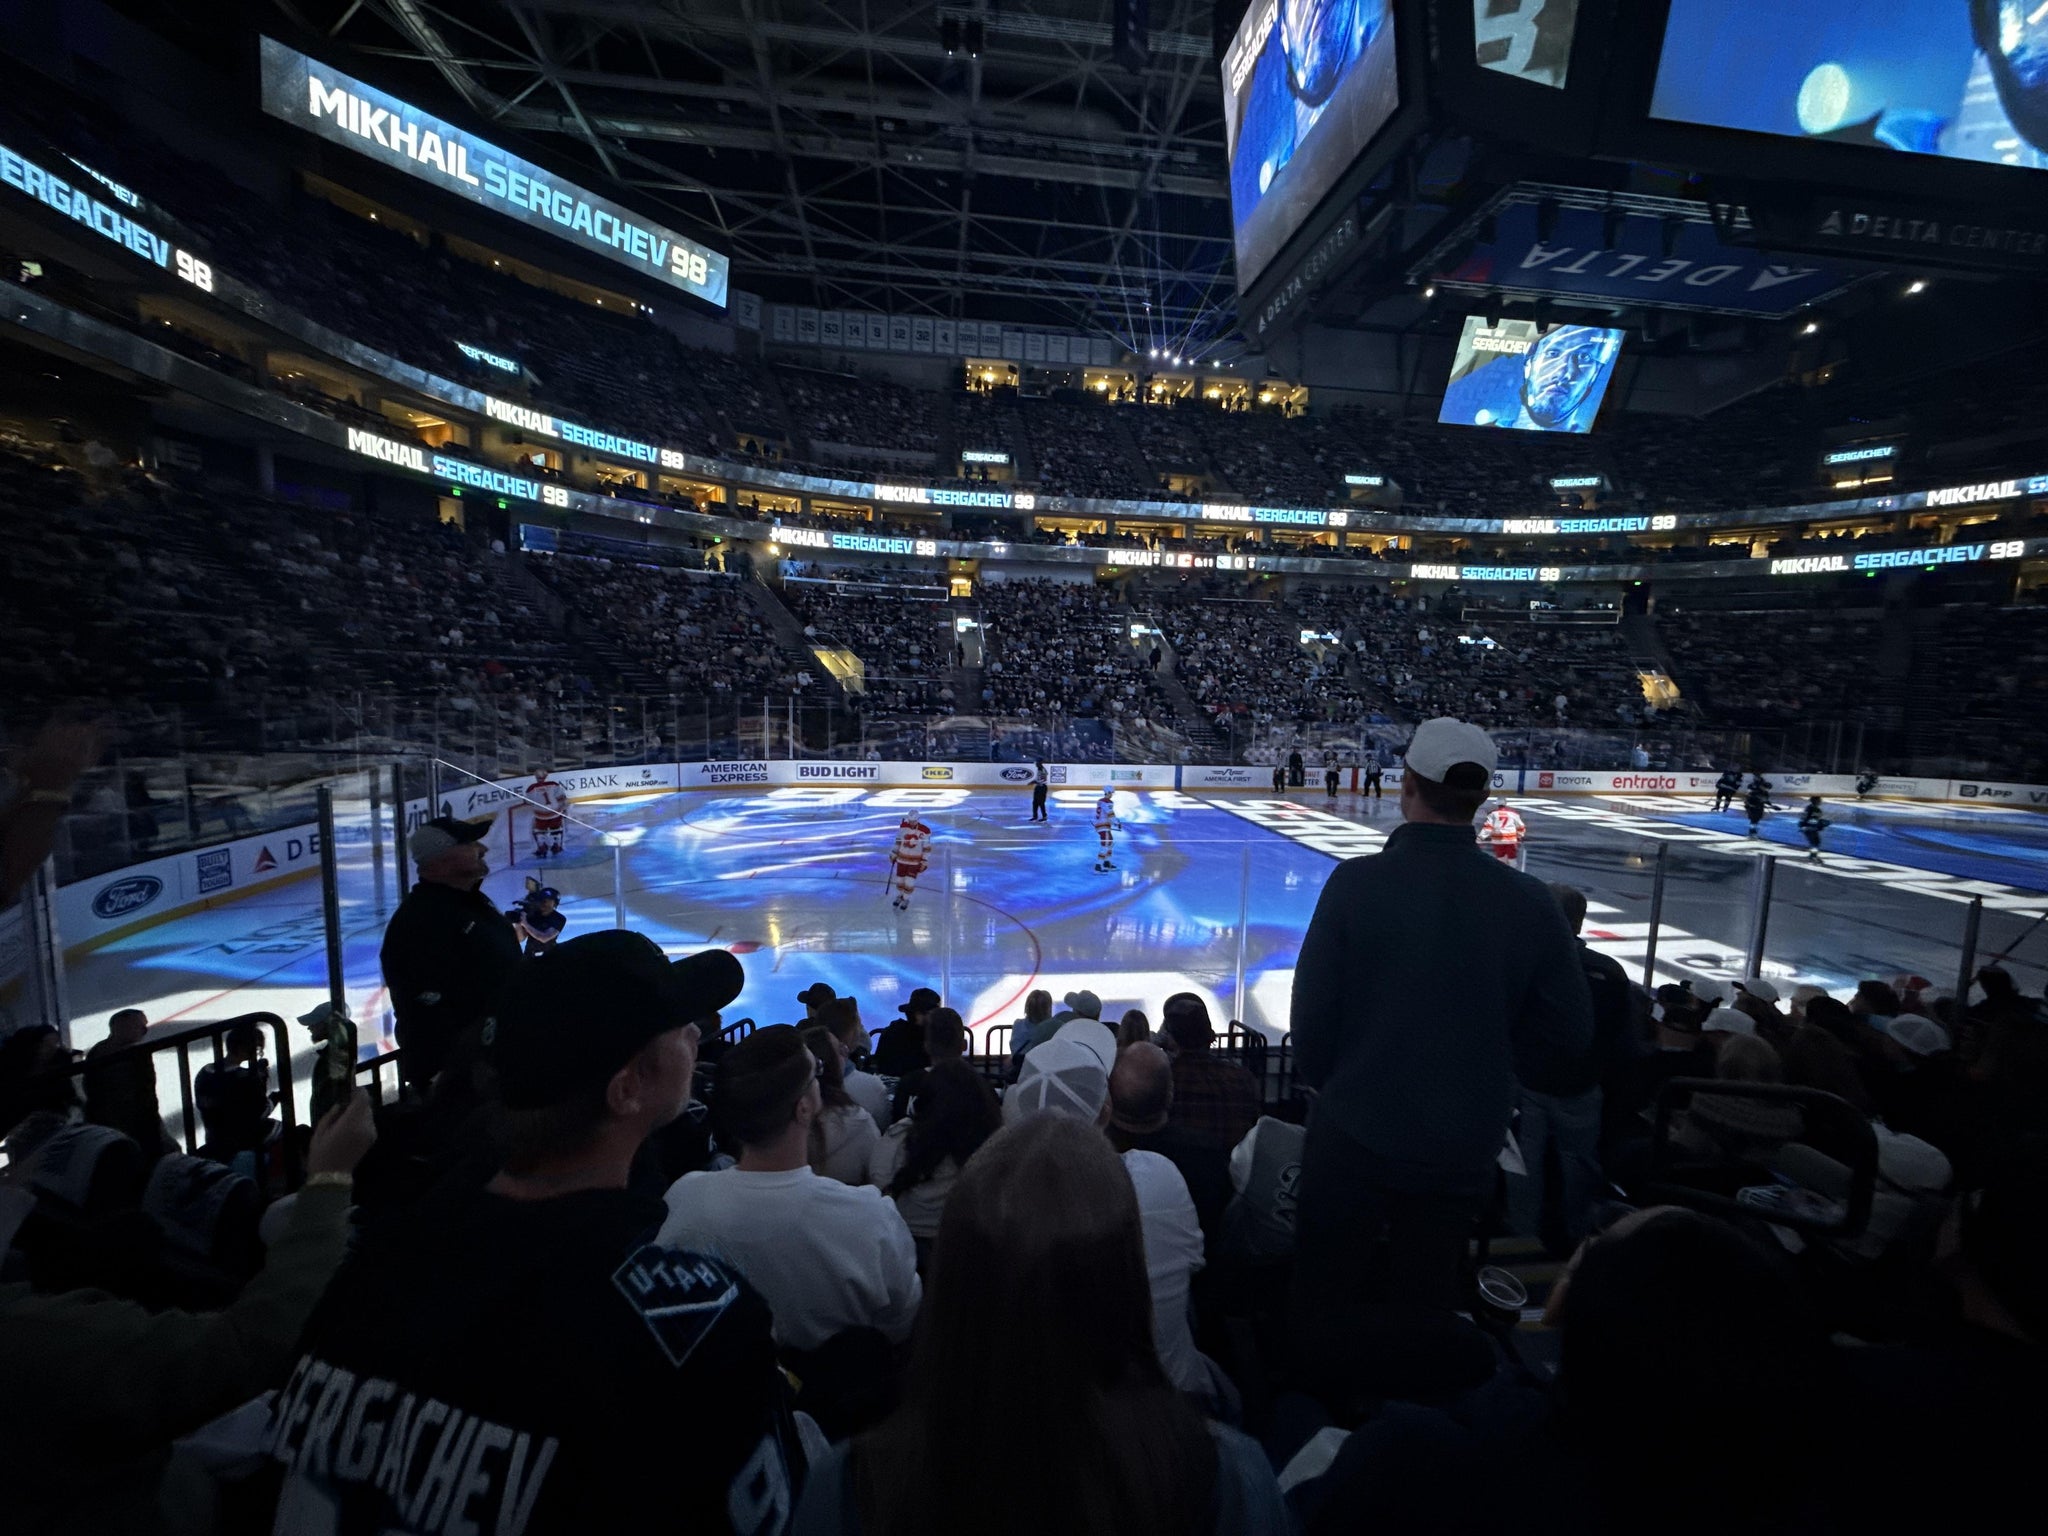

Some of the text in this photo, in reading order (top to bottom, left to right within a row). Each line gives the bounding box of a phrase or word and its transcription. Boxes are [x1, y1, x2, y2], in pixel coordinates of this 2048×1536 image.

[309, 76, 707, 286] MIKHAIL SERGACHEV 98
[0, 144, 168, 268] ERGACHEV
[176, 249, 213, 292] 98
[1851, 213, 1941, 243] DELTA
[1520, 243, 1742, 286] DELTA
[1267, 277, 1302, 321] DELTA
[1472, 337, 1532, 354] SERGACHEV
[486, 396, 684, 470] MIKHAIL SERGACHEV 98
[1830, 447, 1892, 462] SERGACHEV
[348, 427, 569, 507] MIKHAIL SERGACHEV 98
[875, 484, 1034, 510] MIKHAIL SERGACHEV 98
[1927, 480, 2022, 506] MIKHAIL
[1202, 505, 1347, 526] MIKHAIL SERGACHEV 98
[1503, 515, 1676, 533] MIKHAIL SERGACHEV 98
[772, 527, 936, 556] MIKHAIL SERGACHEV 98
[1108, 551, 1152, 565] MIKHAI
[1771, 541, 2024, 574] MIKHAIL SERGACHEV 98
[1411, 564, 1560, 581] MIKHAIL SERGACHEV 98
[701, 763, 767, 773] AMERICAN
[799, 766, 877, 778] BUD LIGHT
[924, 769, 951, 777] IKEA
[1006, 769, 1028, 780] Ford
[580, 775, 619, 790] BANK
[711, 773, 768, 782] EXPRESS
[1557, 776, 1592, 785] TOYOTA
[1612, 775, 1676, 789] entrata
[1499, 816, 1508, 829] 7
[627, 1261, 717, 1297] UTAH
